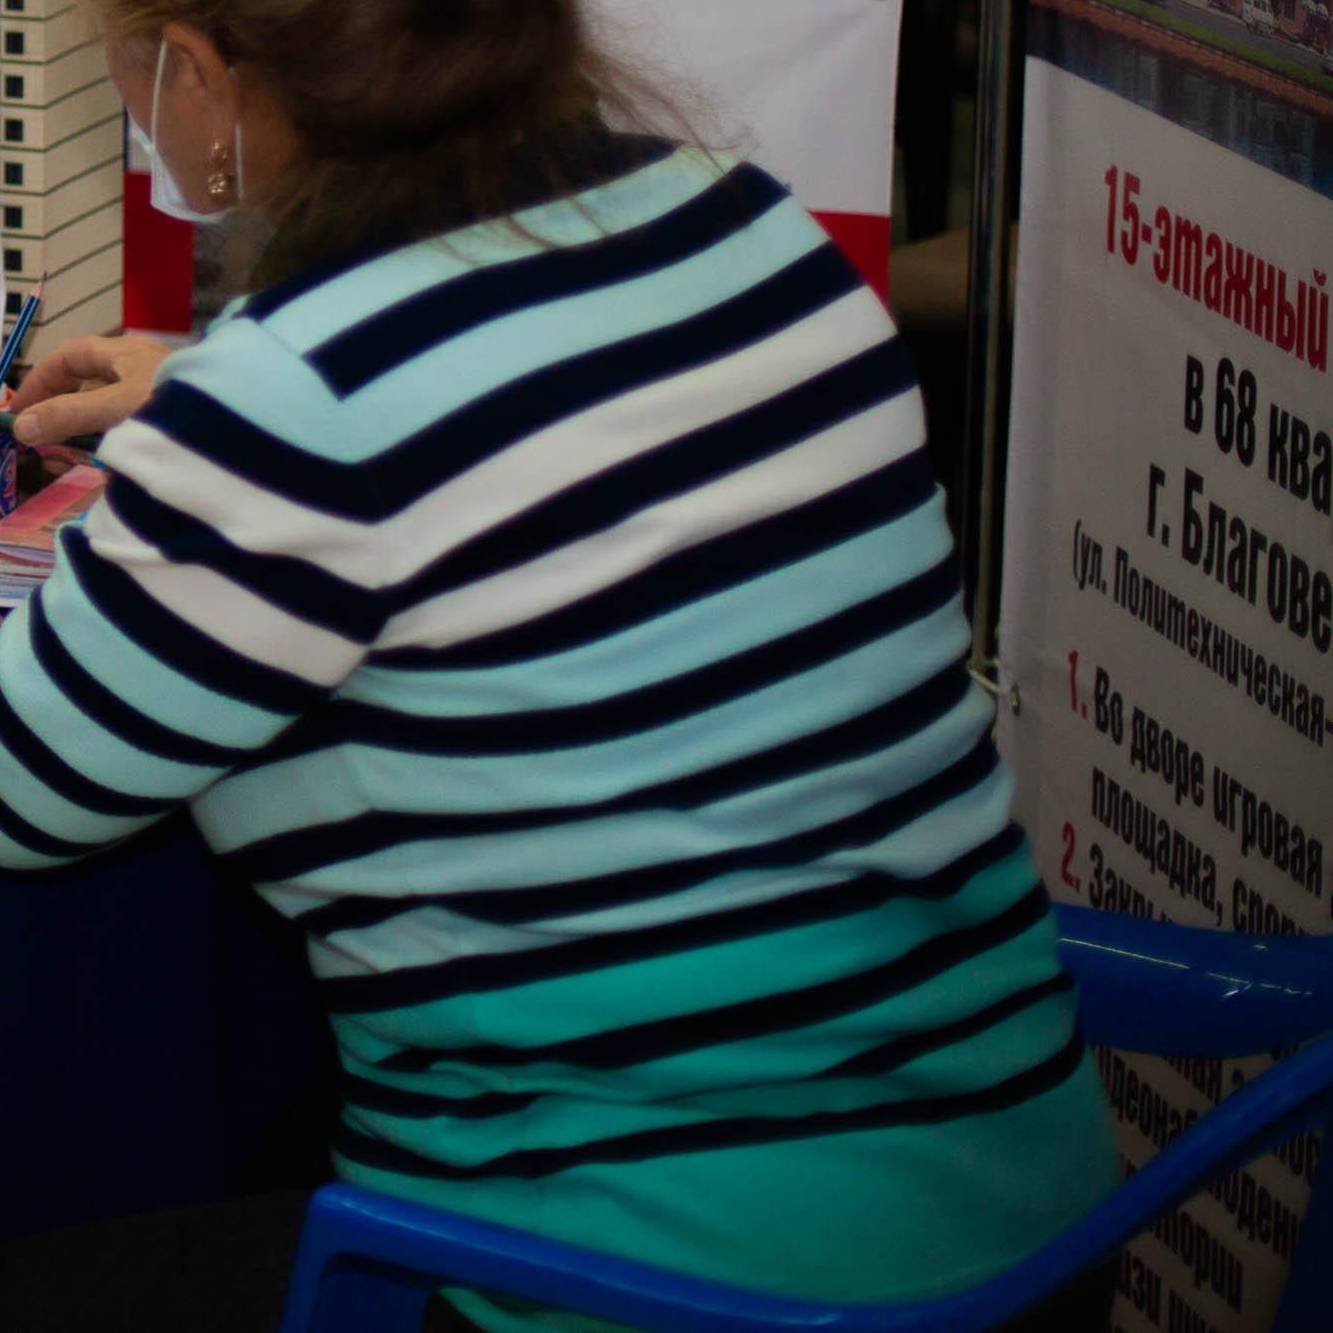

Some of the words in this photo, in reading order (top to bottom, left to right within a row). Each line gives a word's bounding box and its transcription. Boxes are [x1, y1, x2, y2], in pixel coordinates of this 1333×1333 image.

[1104, 164, 1329, 373] 15-этажный
[1214, 357, 1258, 467] 68
[1268, 402, 1333, 516] ква
[1073, 518, 1107, 596] (ул.
[1146, 463, 1170, 549] г.
[1180, 466, 1333, 654] Благове
[1068, 650, 1088, 719] 1.
[1093, 666, 1124, 746] Во
[1130, 705, 1205, 808] дворе
[1212, 764, 1324, 899] игровая
[1092, 765, 1223, 927] площадка,
[1060, 821, 1081, 894] 2.
